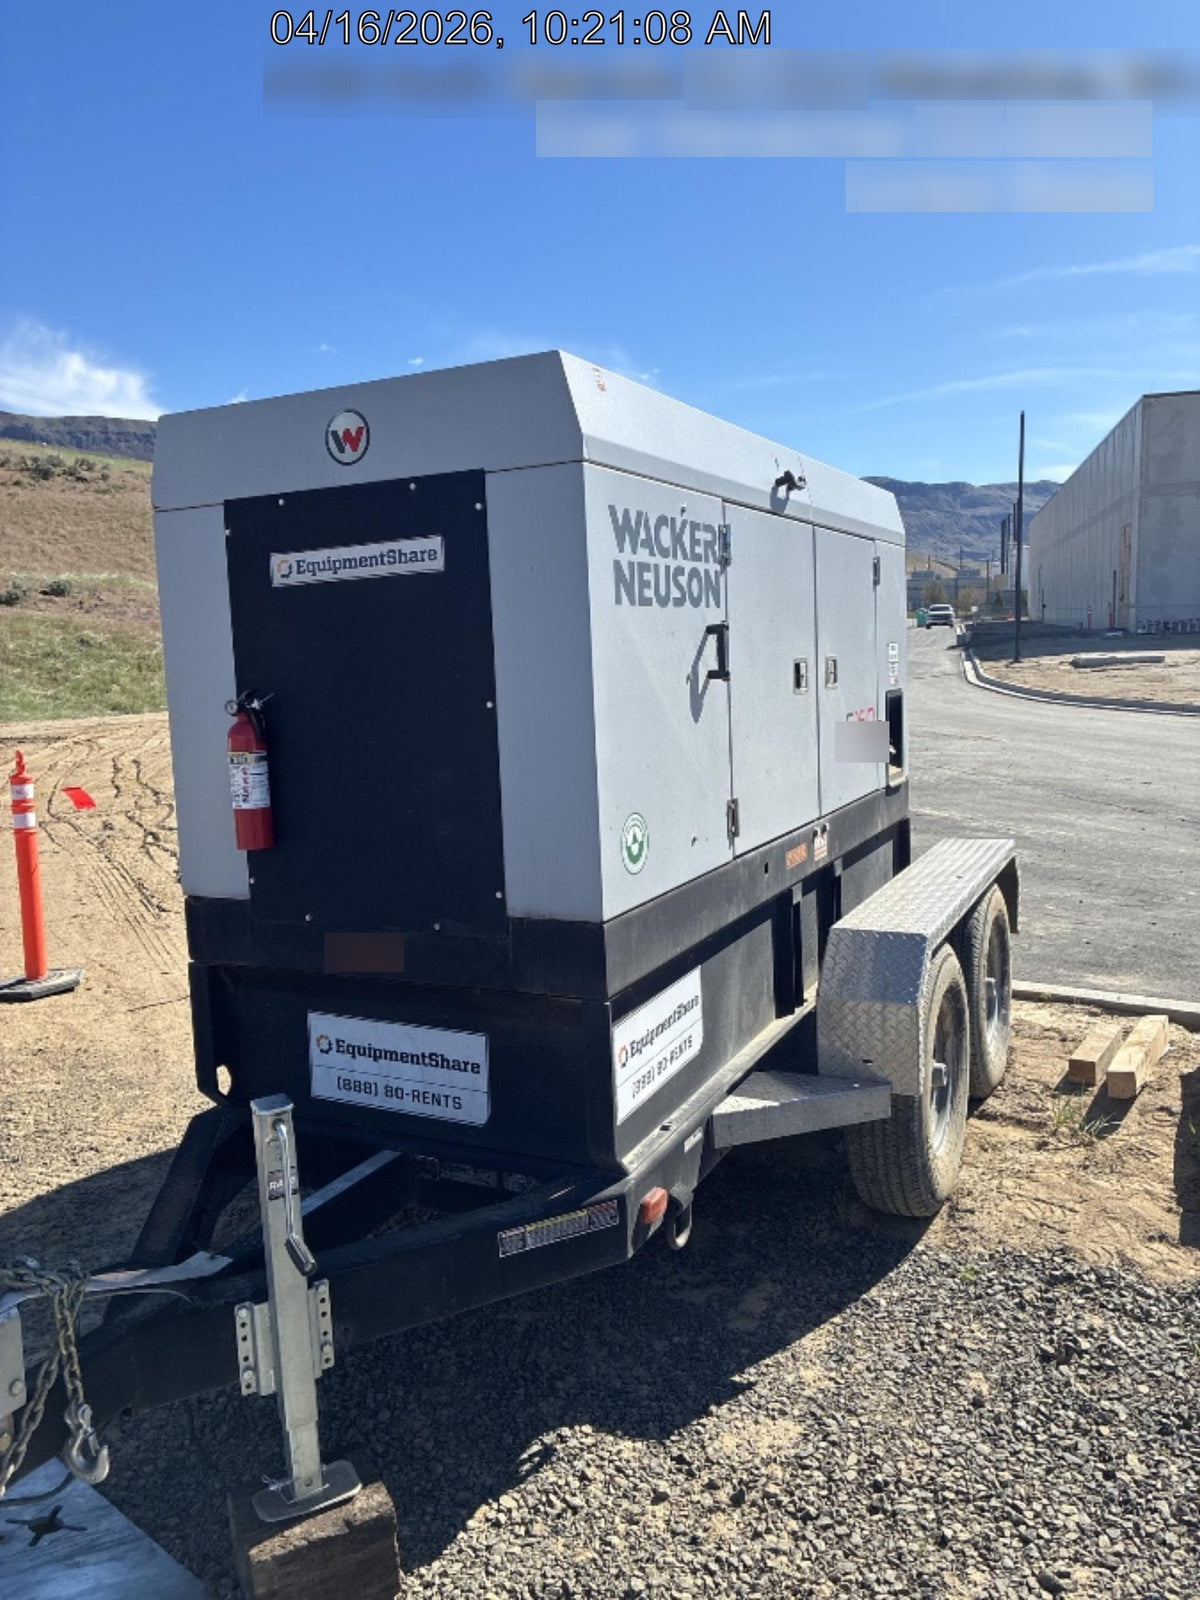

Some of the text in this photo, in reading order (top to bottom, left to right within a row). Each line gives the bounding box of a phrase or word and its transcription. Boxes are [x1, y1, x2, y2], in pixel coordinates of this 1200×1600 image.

[608, 504, 720, 564] WACKER
[295, 548, 438, 576] EquipmentShare
[613, 559, 721, 609] NEUSON
[335, 1038, 481, 1075] EquipmentShare
[337, 1076, 463, 1110] (888) 80-RENTS
